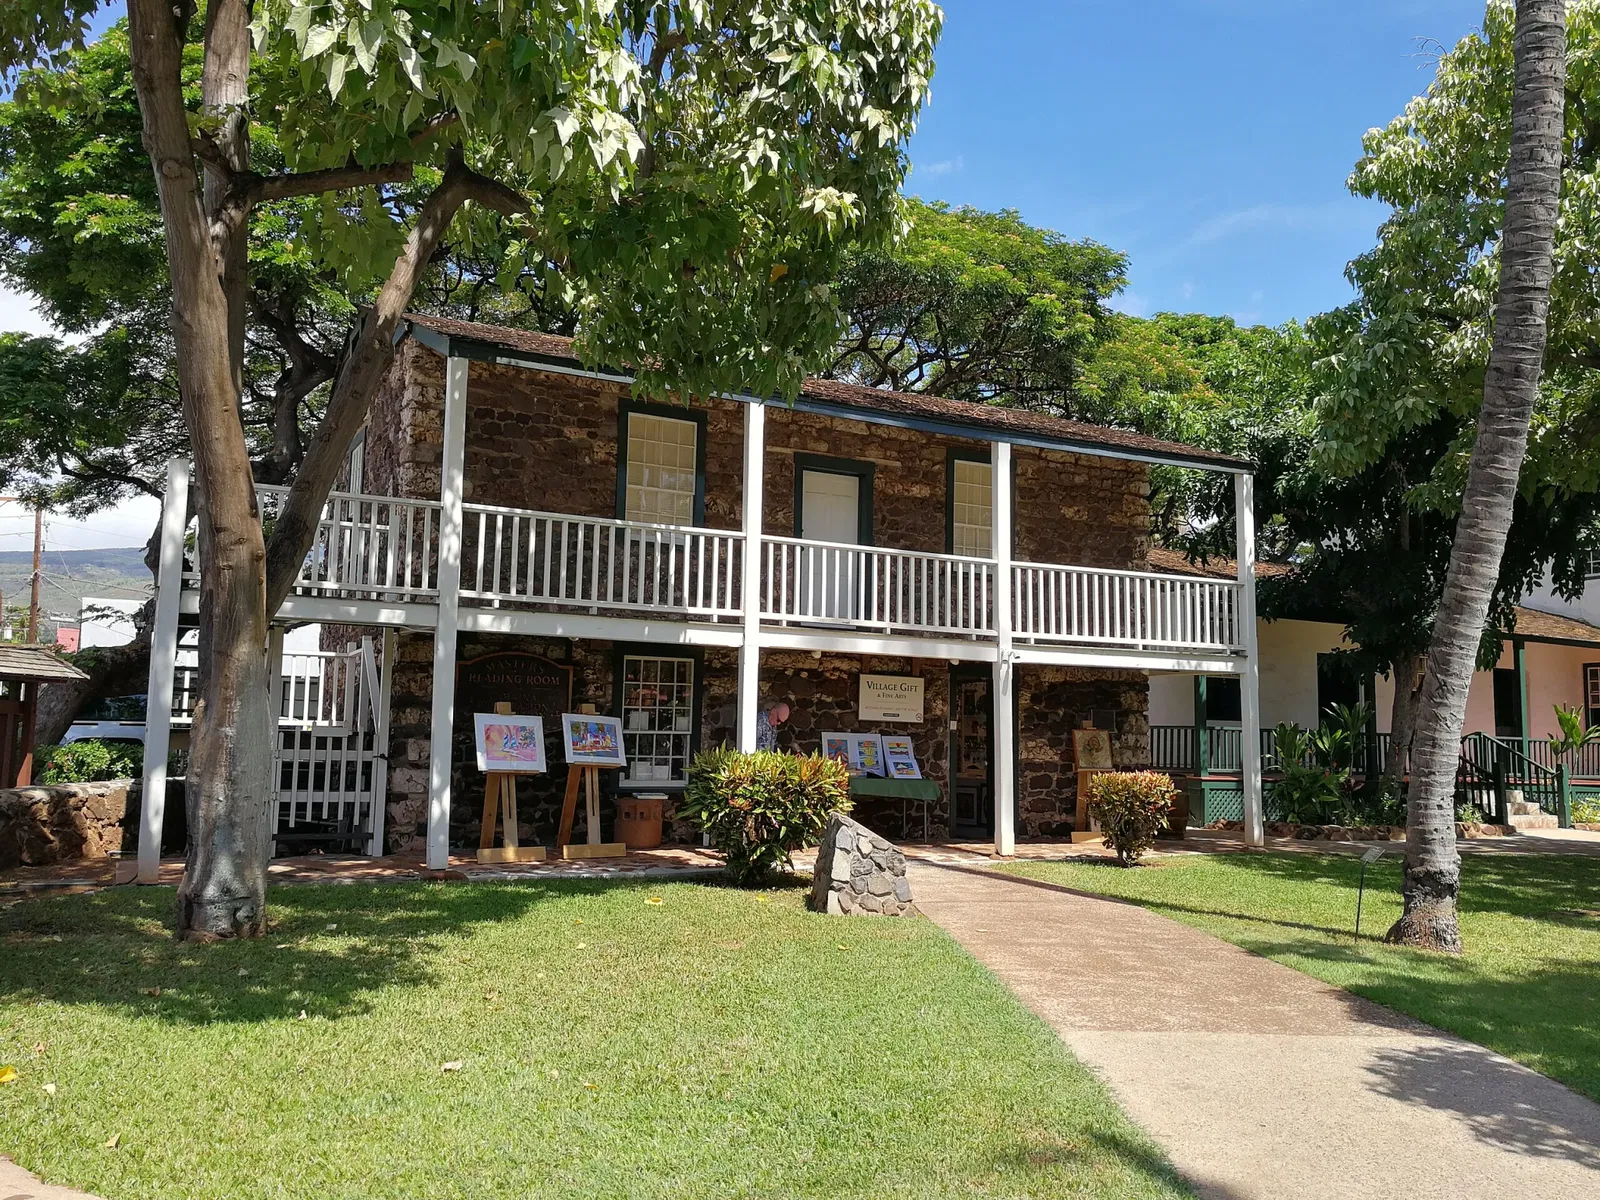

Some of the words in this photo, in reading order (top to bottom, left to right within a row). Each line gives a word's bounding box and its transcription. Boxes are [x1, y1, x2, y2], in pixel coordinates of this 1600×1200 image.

[469, 673, 522, 684] READING
[526, 675, 560, 686] ROOM
[866, 680, 898, 692] VILLAGE
[900, 682, 919, 693] GIFT
